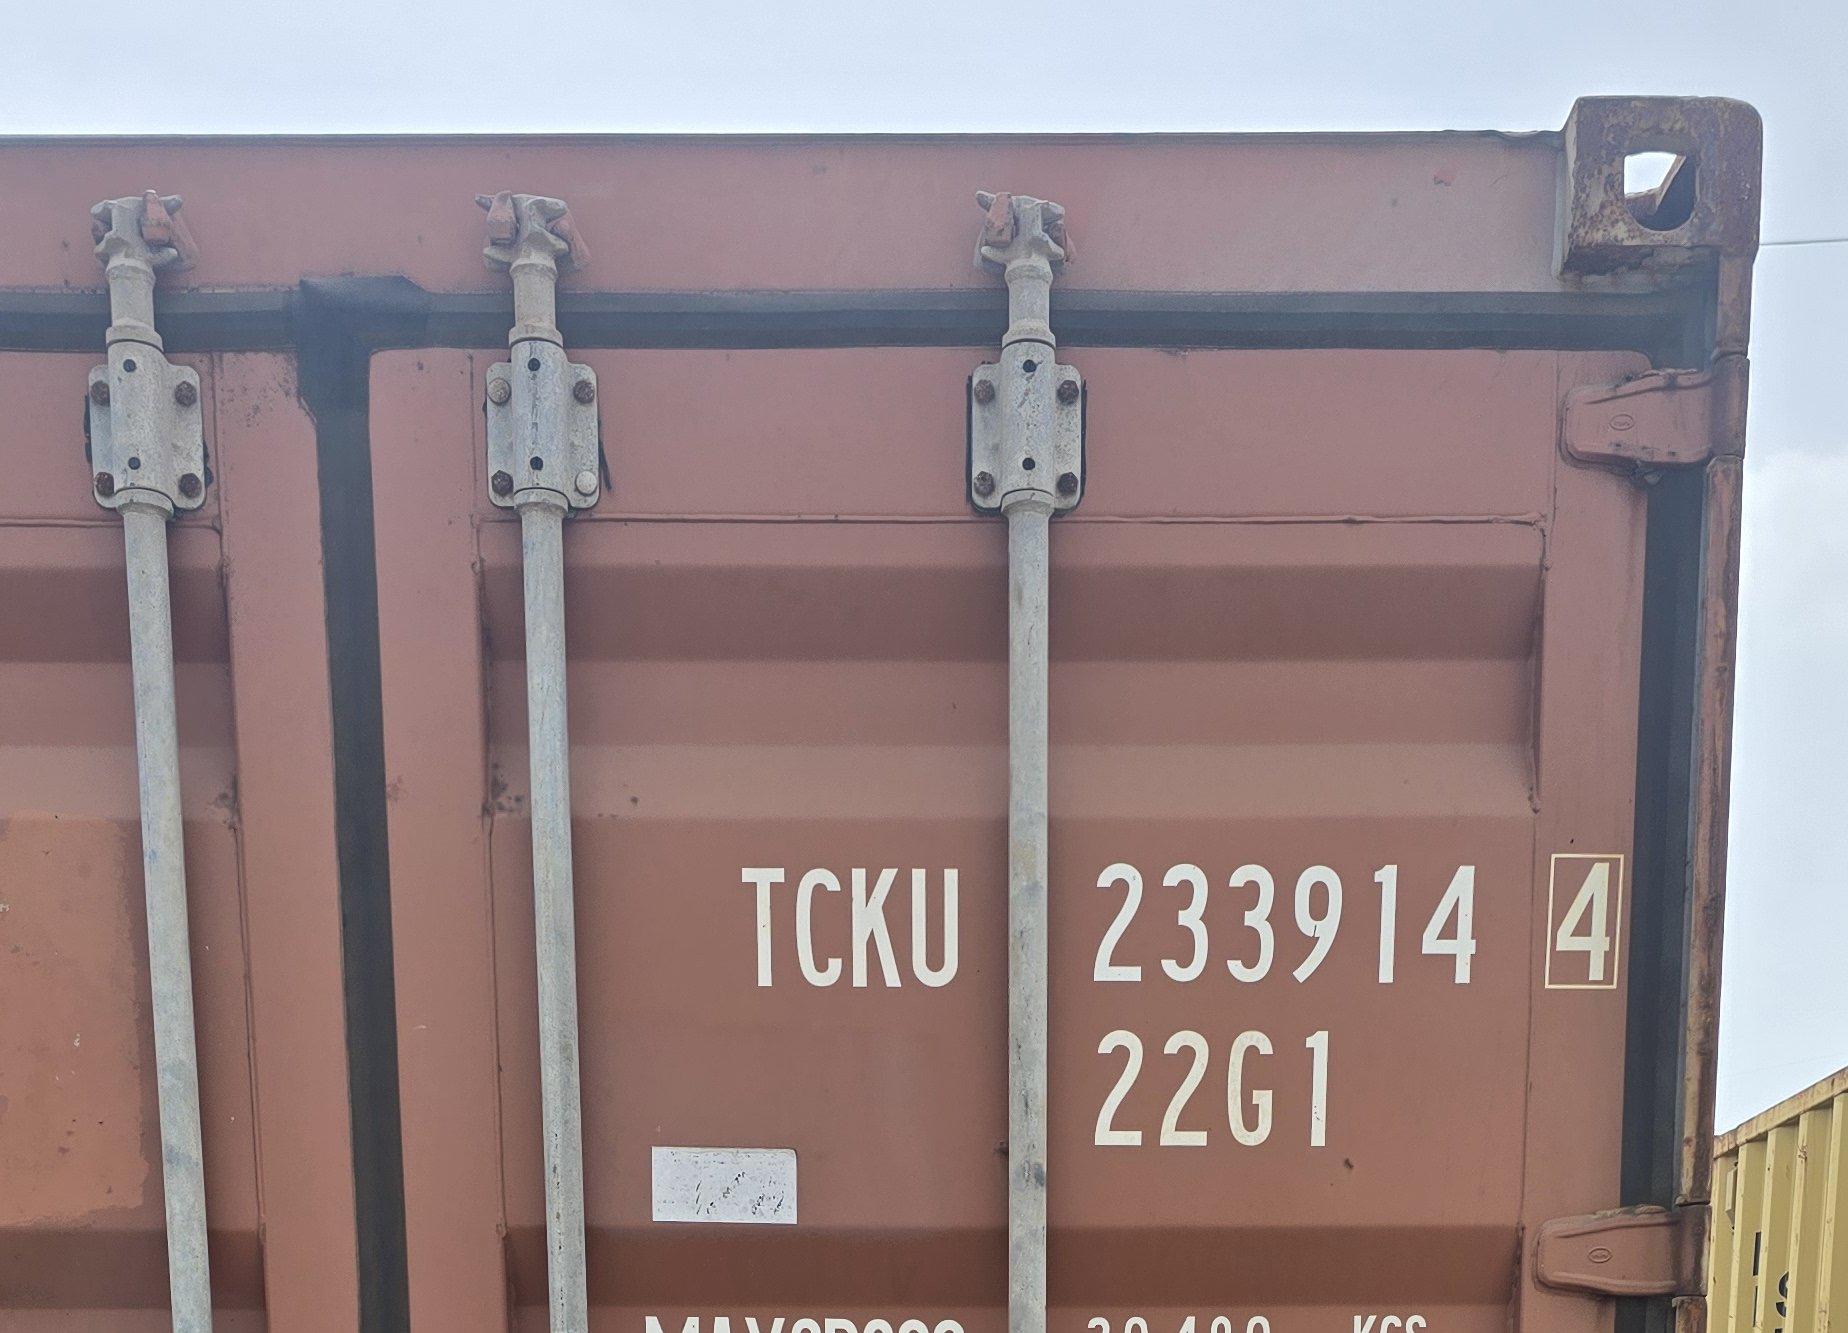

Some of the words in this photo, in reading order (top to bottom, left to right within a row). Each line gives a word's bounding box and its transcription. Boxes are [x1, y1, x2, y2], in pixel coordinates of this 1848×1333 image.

[742, 868, 959, 988] TCKU
[1094, 863, 1476, 984] 233914
[1556, 862, 1610, 981] 4
[1095, 1030, 1328, 1147] 22G1
